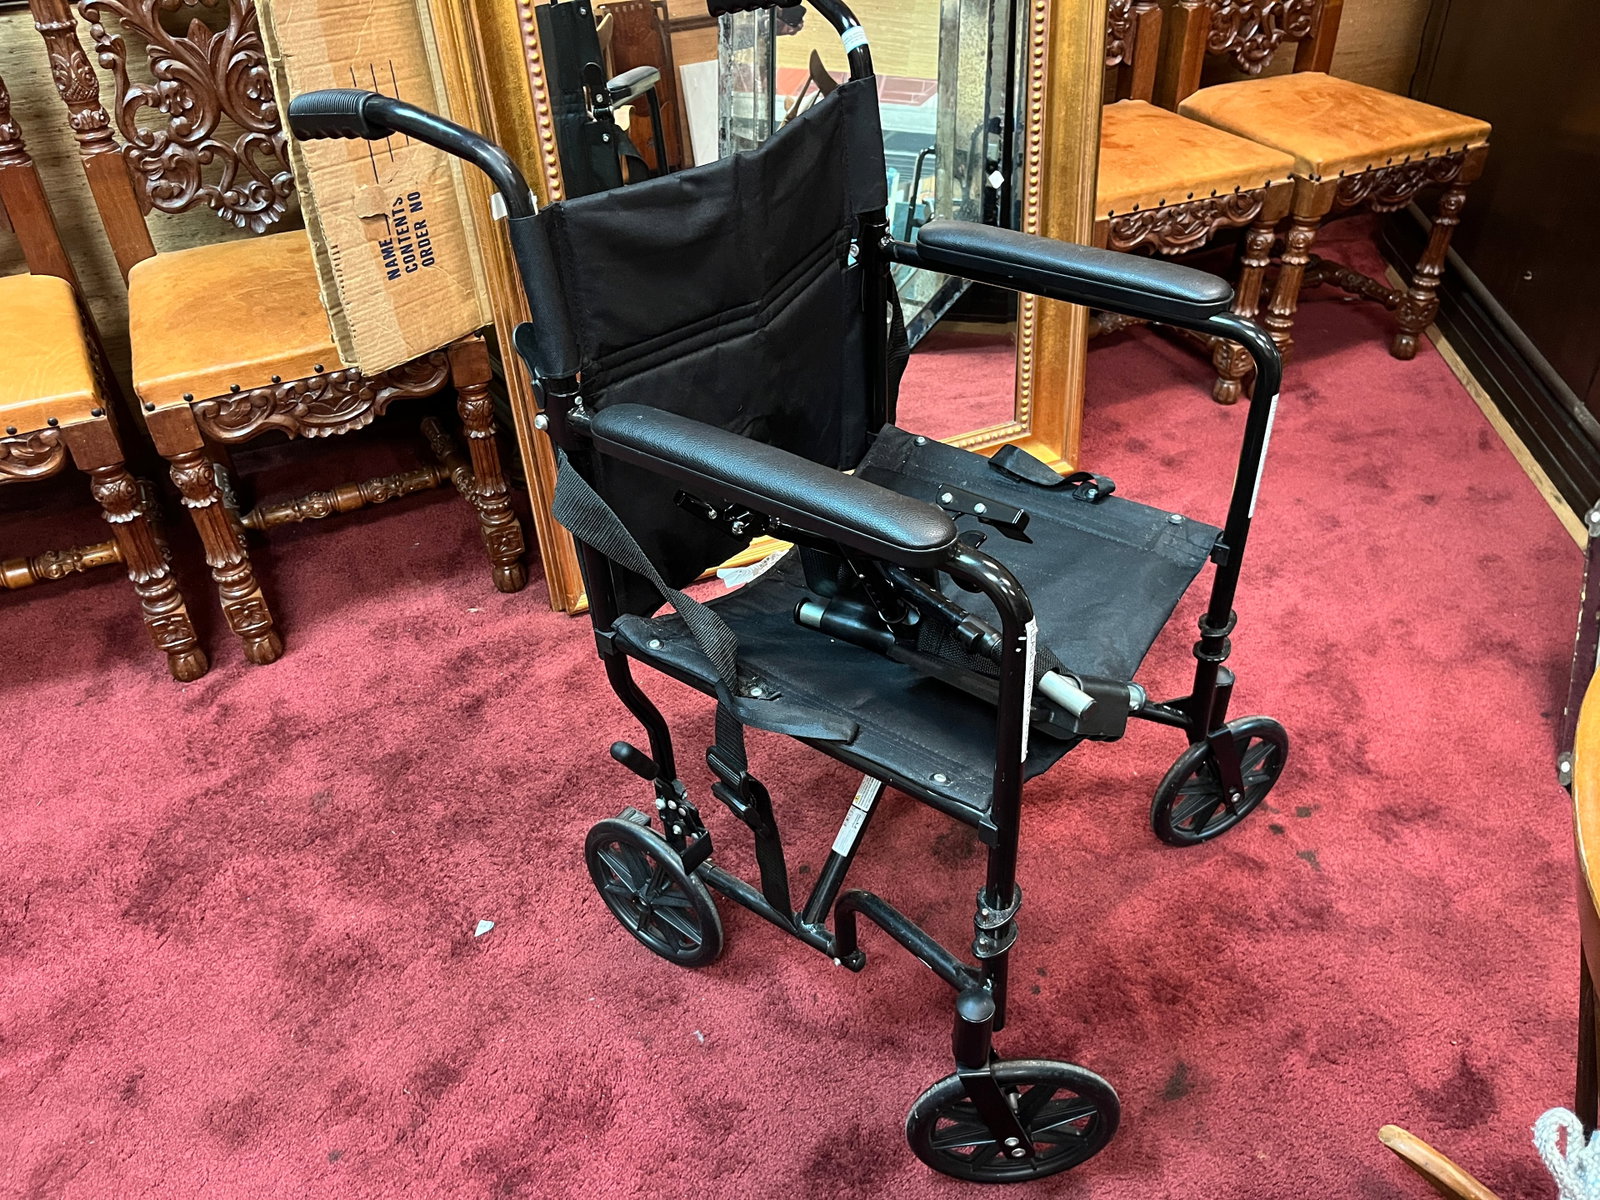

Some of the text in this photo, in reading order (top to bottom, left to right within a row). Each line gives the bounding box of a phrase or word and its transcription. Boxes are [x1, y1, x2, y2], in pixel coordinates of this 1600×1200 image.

[407, 191, 435, 267] ORDER NO
[378, 238, 401, 281] NAME
